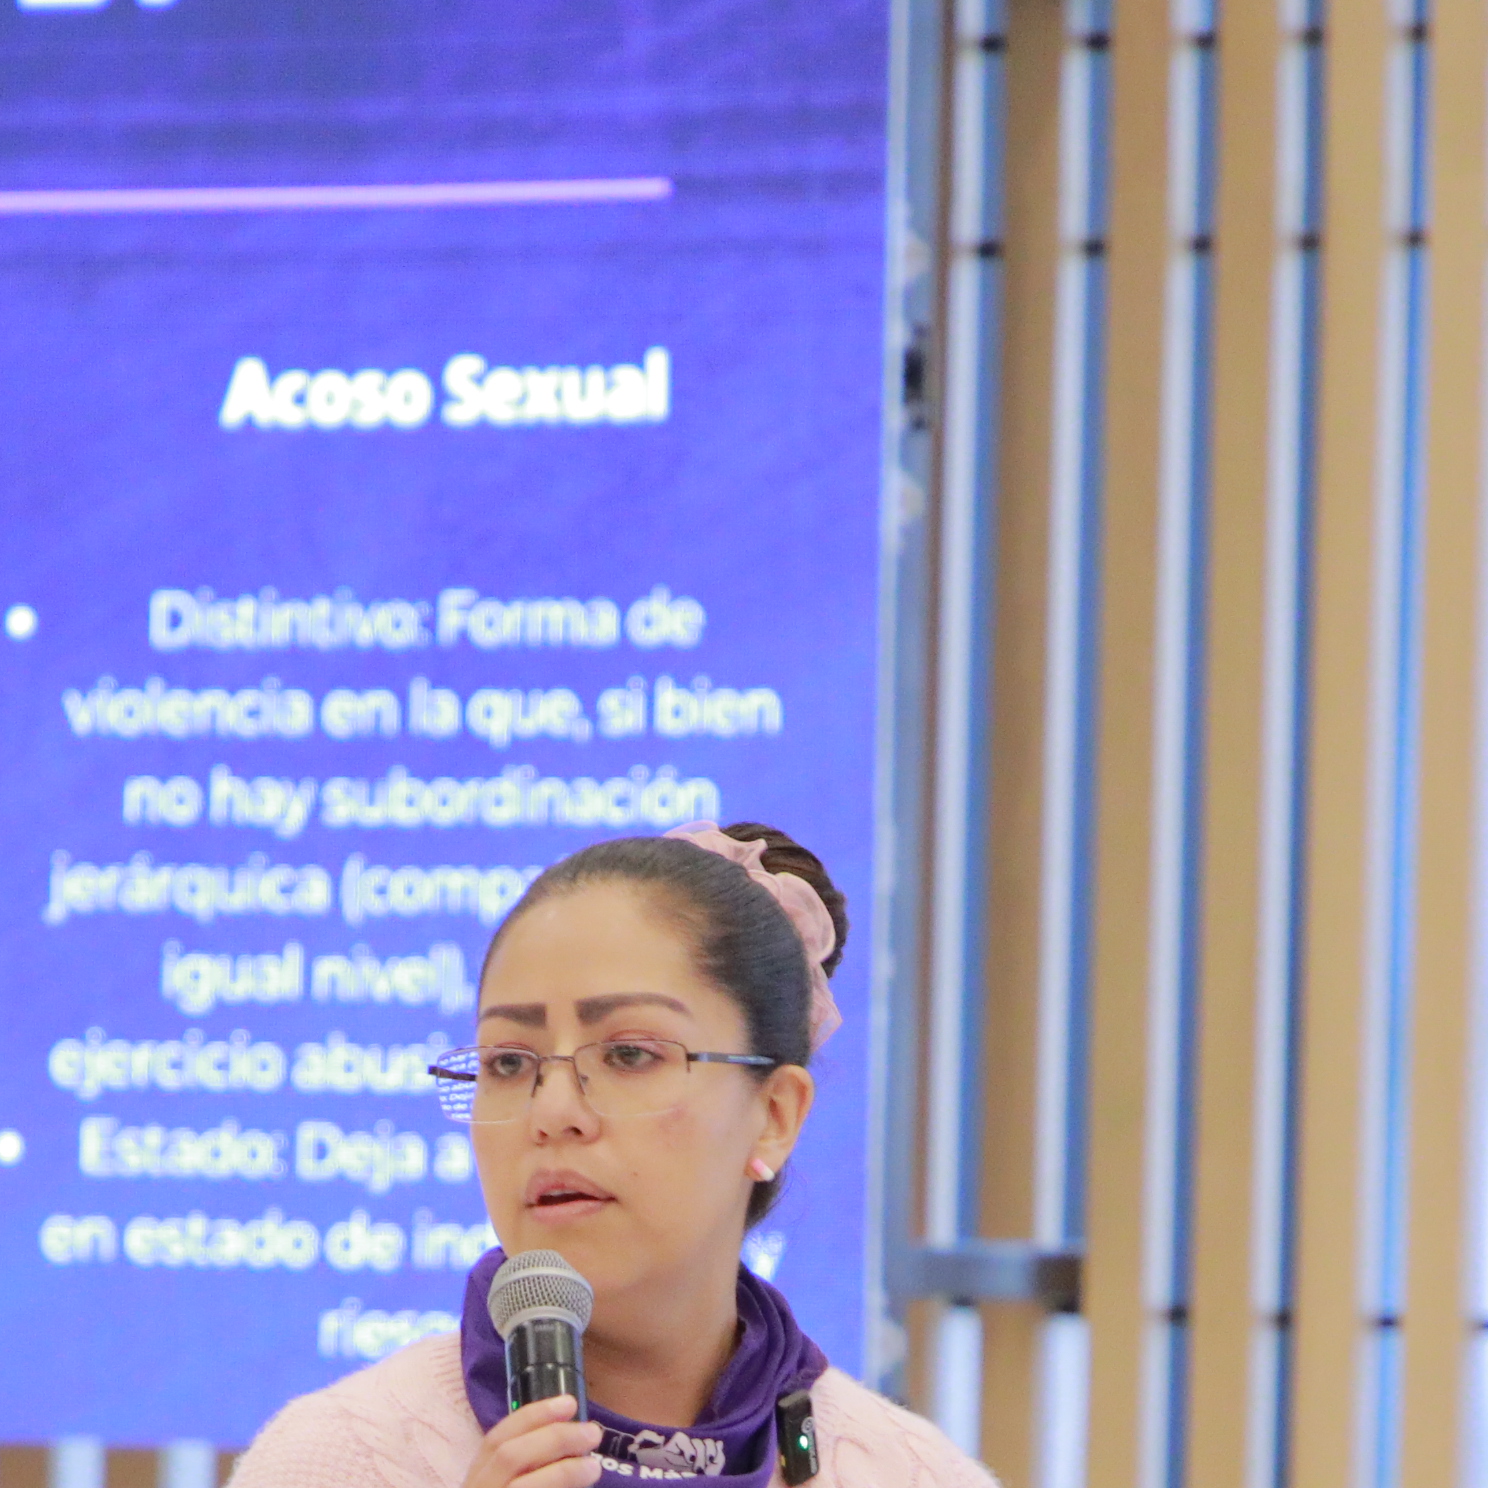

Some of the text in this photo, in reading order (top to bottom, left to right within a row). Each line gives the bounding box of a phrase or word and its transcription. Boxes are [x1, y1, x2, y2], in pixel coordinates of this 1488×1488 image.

[219, 346, 669, 429] Acoso Sexual
[149, 587, 705, 650] Distintivo: Forma de
[63, 675, 783, 747] violencia en la que, si bien
[123, 764, 721, 838] no hay subordinación
[43, 850, 542, 927] jerárquica (comp
[162, 939, 303, 1015] igual
[48, 1027, 286, 1098] ejercicio
[78, 1116, 473, 1193] Estado: Deja a
[39, 1213, 117, 1264] en
[123, 1207, 320, 1269] estado
[323, 1208, 406, 1272] de
[412, 1206, 501, 1271] ind
